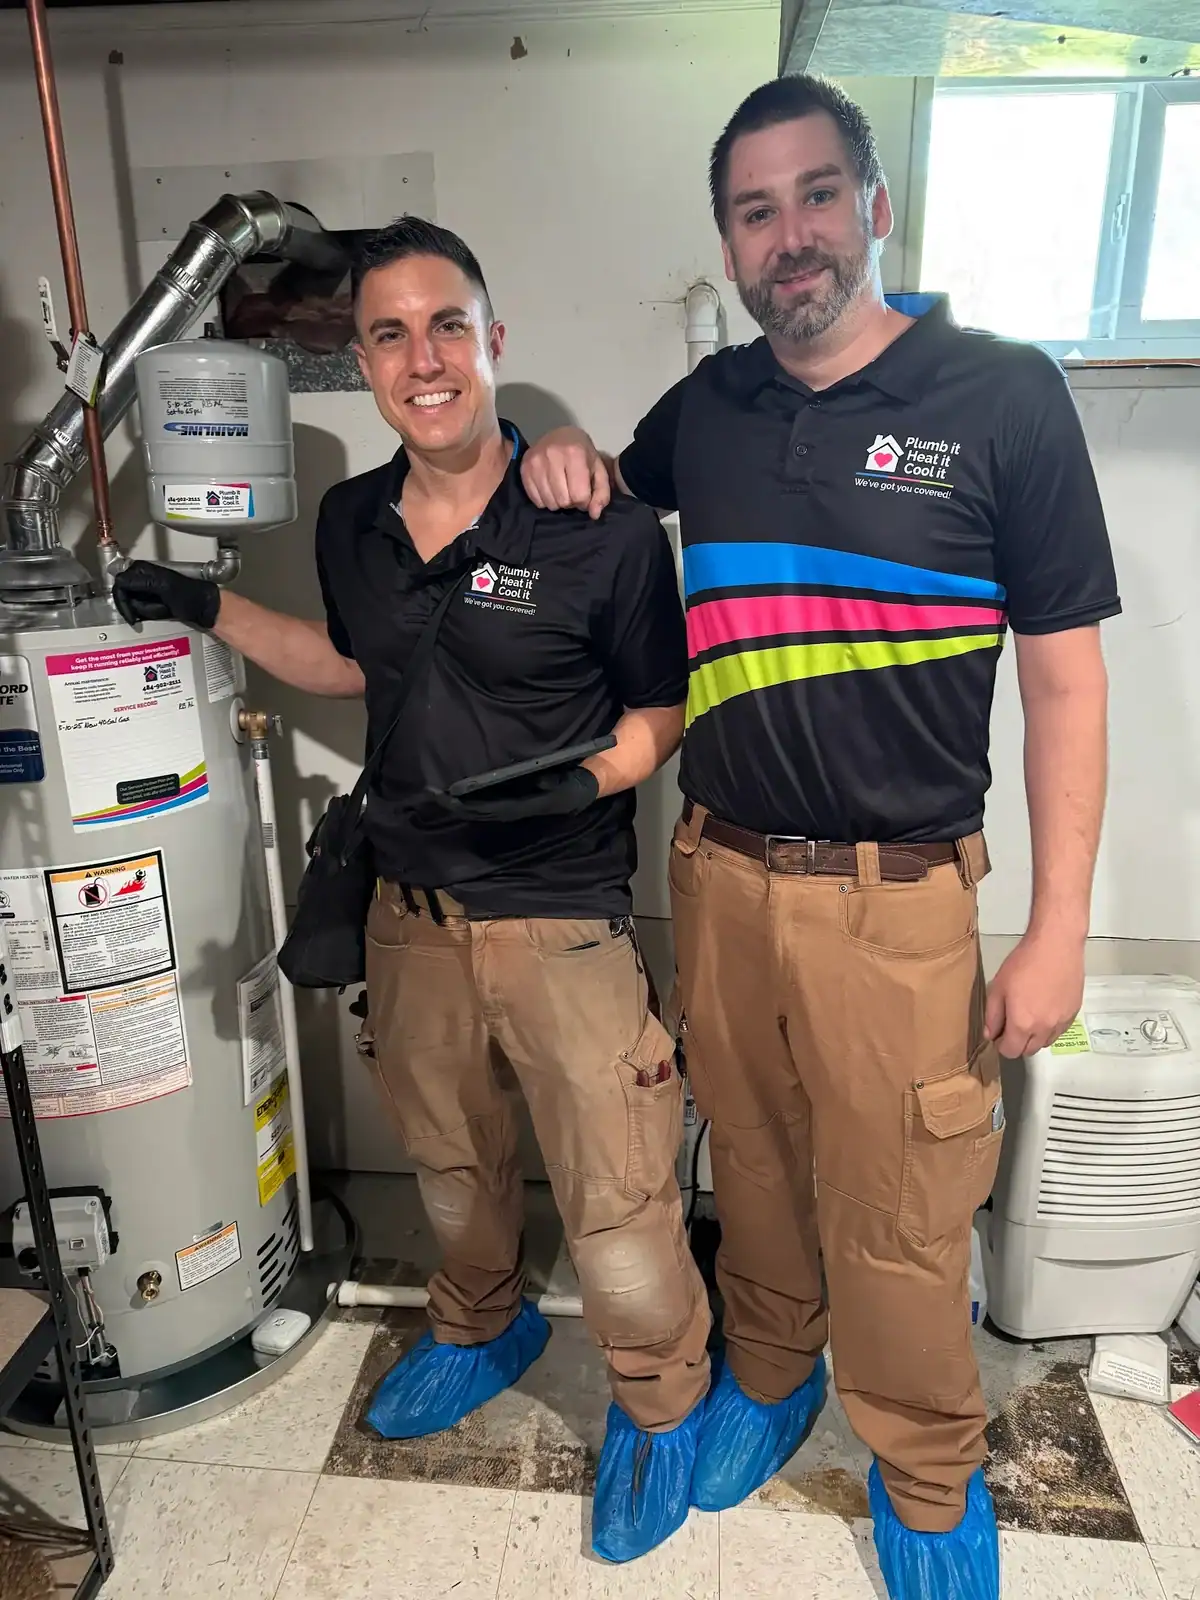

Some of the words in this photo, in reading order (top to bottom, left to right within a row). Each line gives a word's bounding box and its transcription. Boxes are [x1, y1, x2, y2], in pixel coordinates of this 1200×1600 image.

[180, 426, 248, 436] MAINLINE
[905, 437, 948, 452] Plumb
[950, 442, 960, 455] it
[907, 450, 938, 465] Heat
[940, 455, 951, 467] it
[904, 463, 934, 477] Cool
[936, 468, 946, 479] it
[854, 478, 879, 488] We've
[880, 482, 895, 491] got
[896, 484, 912, 493] you
[914, 486, 952, 499] covered!
[498, 564, 530, 578] Plumb
[532, 570, 540, 580] it
[500, 576, 525, 588] Heat
[525, 580, 533, 590] it
[498, 587, 522, 598] Cool
[522, 590, 530, 600] it
[464, 597, 481, 605] We've
[481, 600, 492, 608] got
[506, 605, 536, 616] covered!
[119, 656, 142, 664] reliably
[113, 704, 136, 712] SERVICE
[137, 700, 158, 708] RECORD
[93, 866, 126, 876] WARNING
